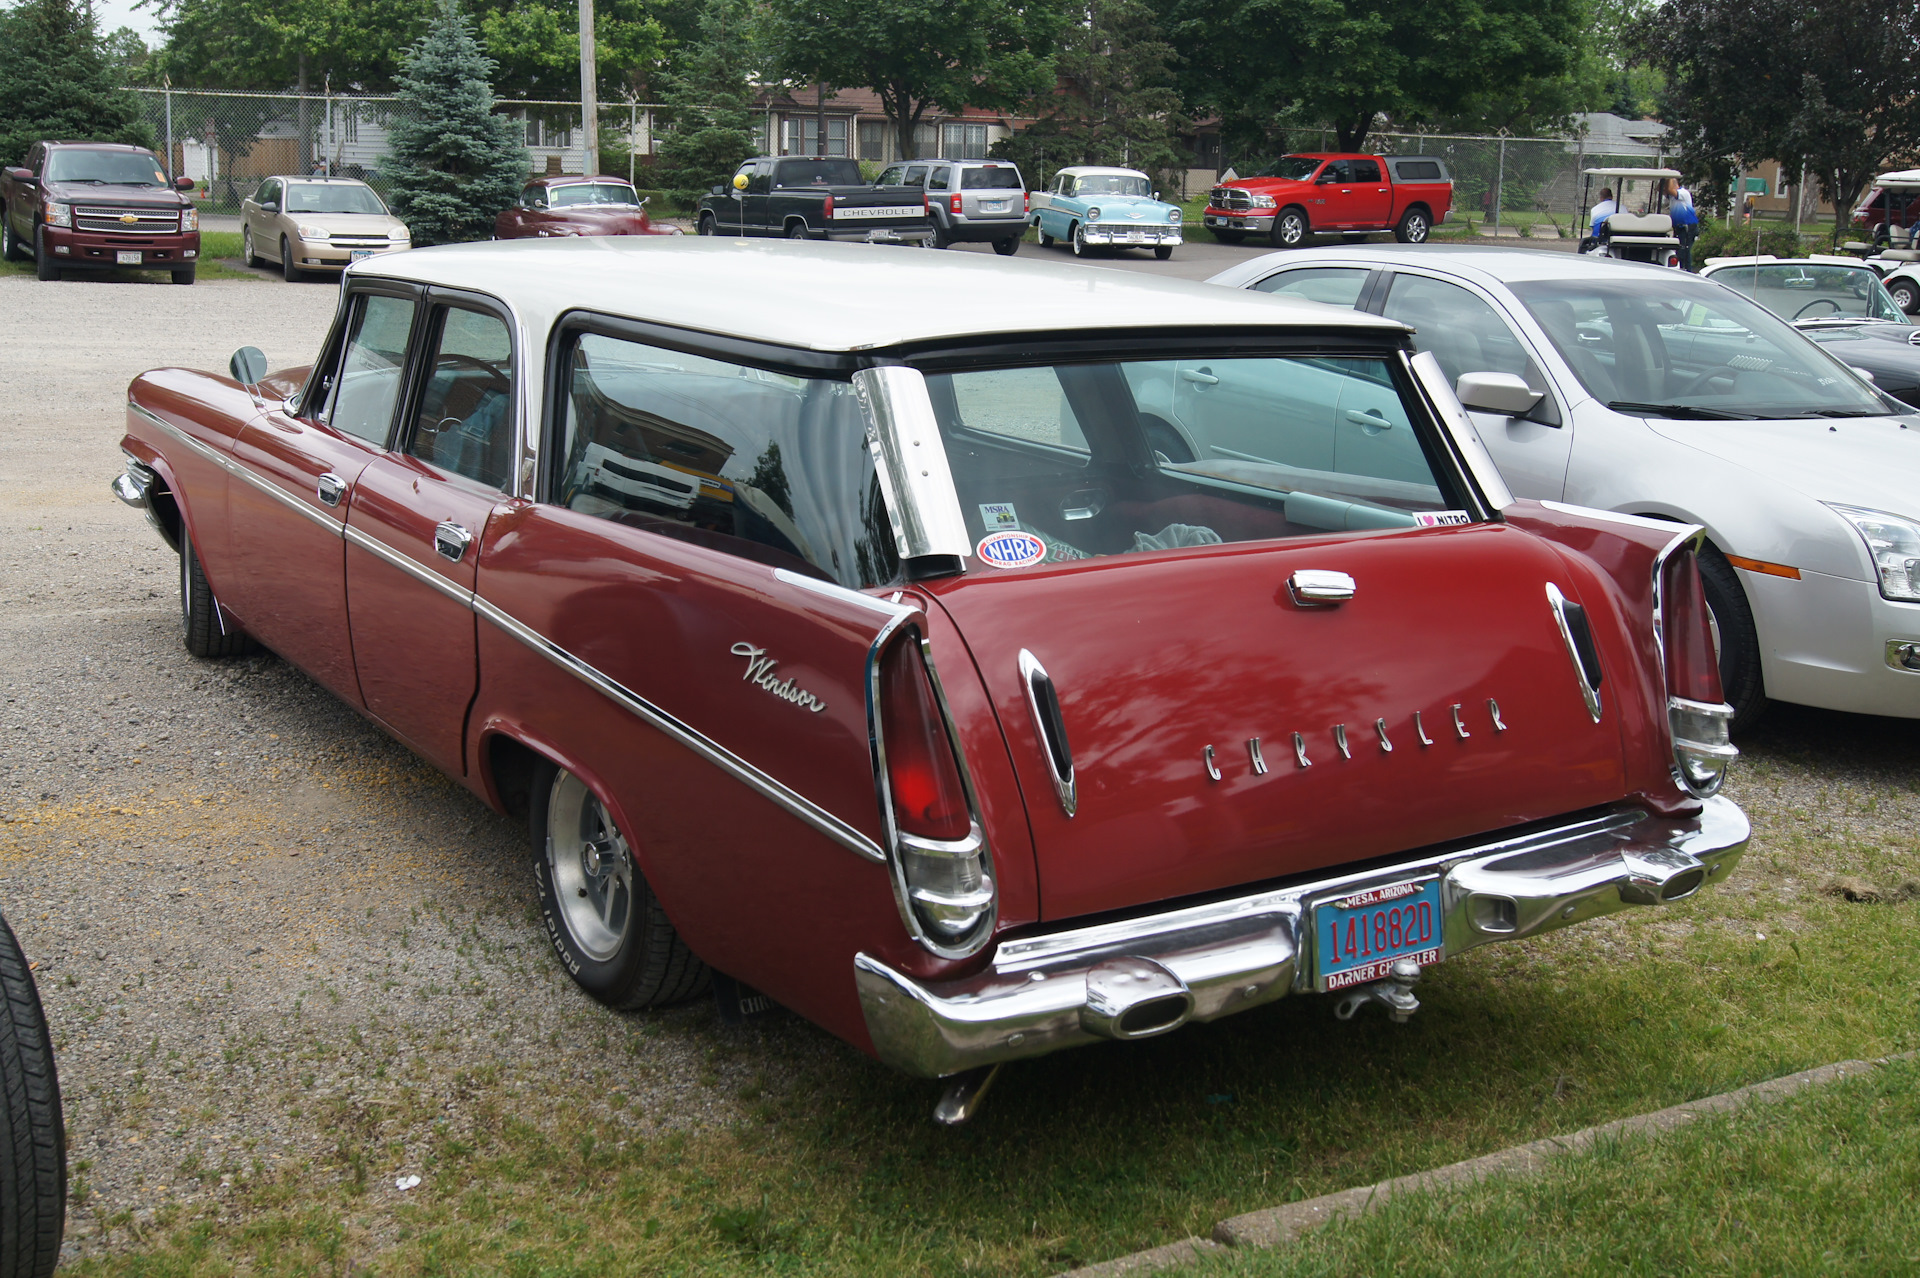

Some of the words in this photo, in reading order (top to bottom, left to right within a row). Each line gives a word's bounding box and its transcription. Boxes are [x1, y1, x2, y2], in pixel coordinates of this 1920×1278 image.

[843, 208, 915, 216] CHEVROLET
[984, 505, 1010, 514] MSRA
[1417, 517, 1422, 526] I
[1436, 515, 1469, 525] NITRO
[985, 533, 1029, 544] CHAMPIONSHIP
[988, 539, 1034, 561] NHRA
[1015, 557, 1036, 566] RACING
[730, 641, 827, 713] Windsor
[1203, 698, 1507, 781] CHRYSLER
[534, 862, 546, 902] T/A
[1346, 892, 1378, 907] MESA,
[1379, 883, 1415, 900] ARIZONA
[544, 910, 581, 976] Radial
[1331, 901, 1433, 964] 141882D
[1328, 966, 1375, 989] DARNER
[1379, 951, 1437, 976] CHSLER
